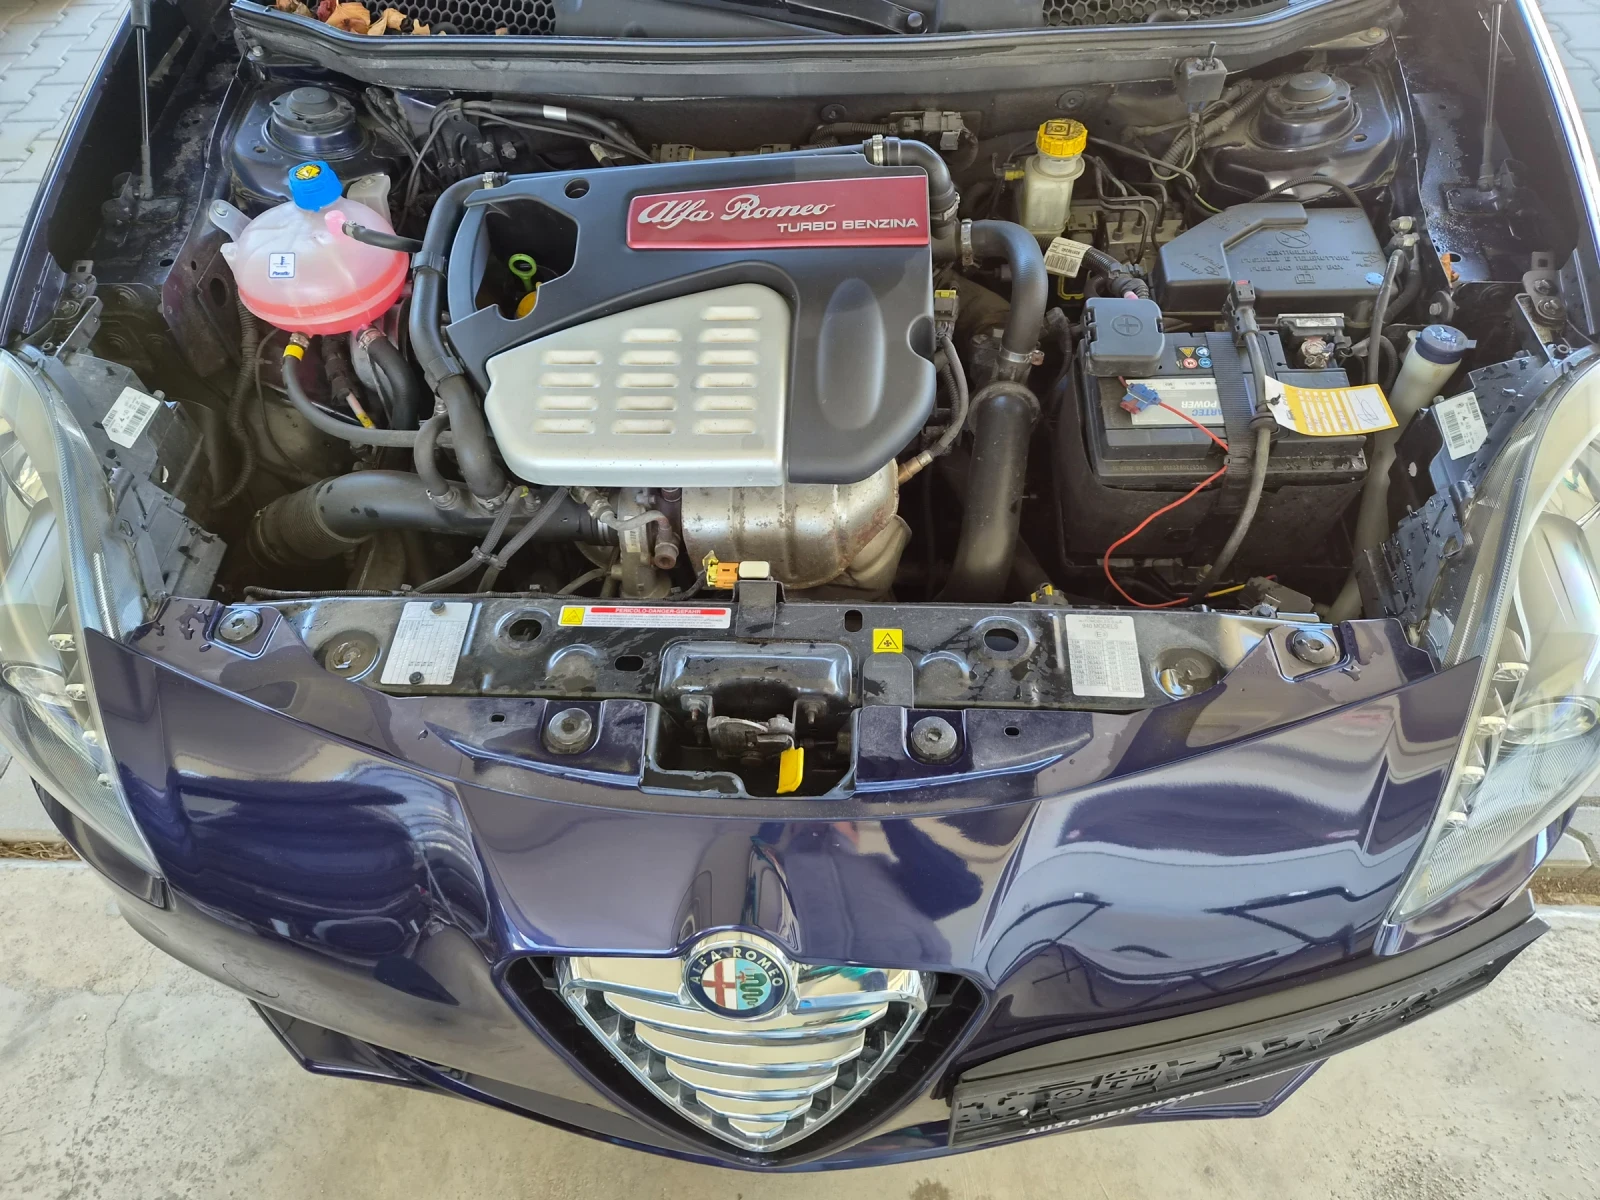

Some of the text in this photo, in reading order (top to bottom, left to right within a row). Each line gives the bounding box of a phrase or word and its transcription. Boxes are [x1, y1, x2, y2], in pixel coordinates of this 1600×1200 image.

[637, 193, 836, 230] Alfa Romeo
[776, 217, 920, 233] TURBO BENZINA
[1181, 400, 1218, 409] POWER
[614, 607, 702, 615] PERICOLO-DANGER-GEFAHR
[689, 946, 784, 987] ALFA ROMEO
[1025, 1118, 1081, 1136] AUTO
